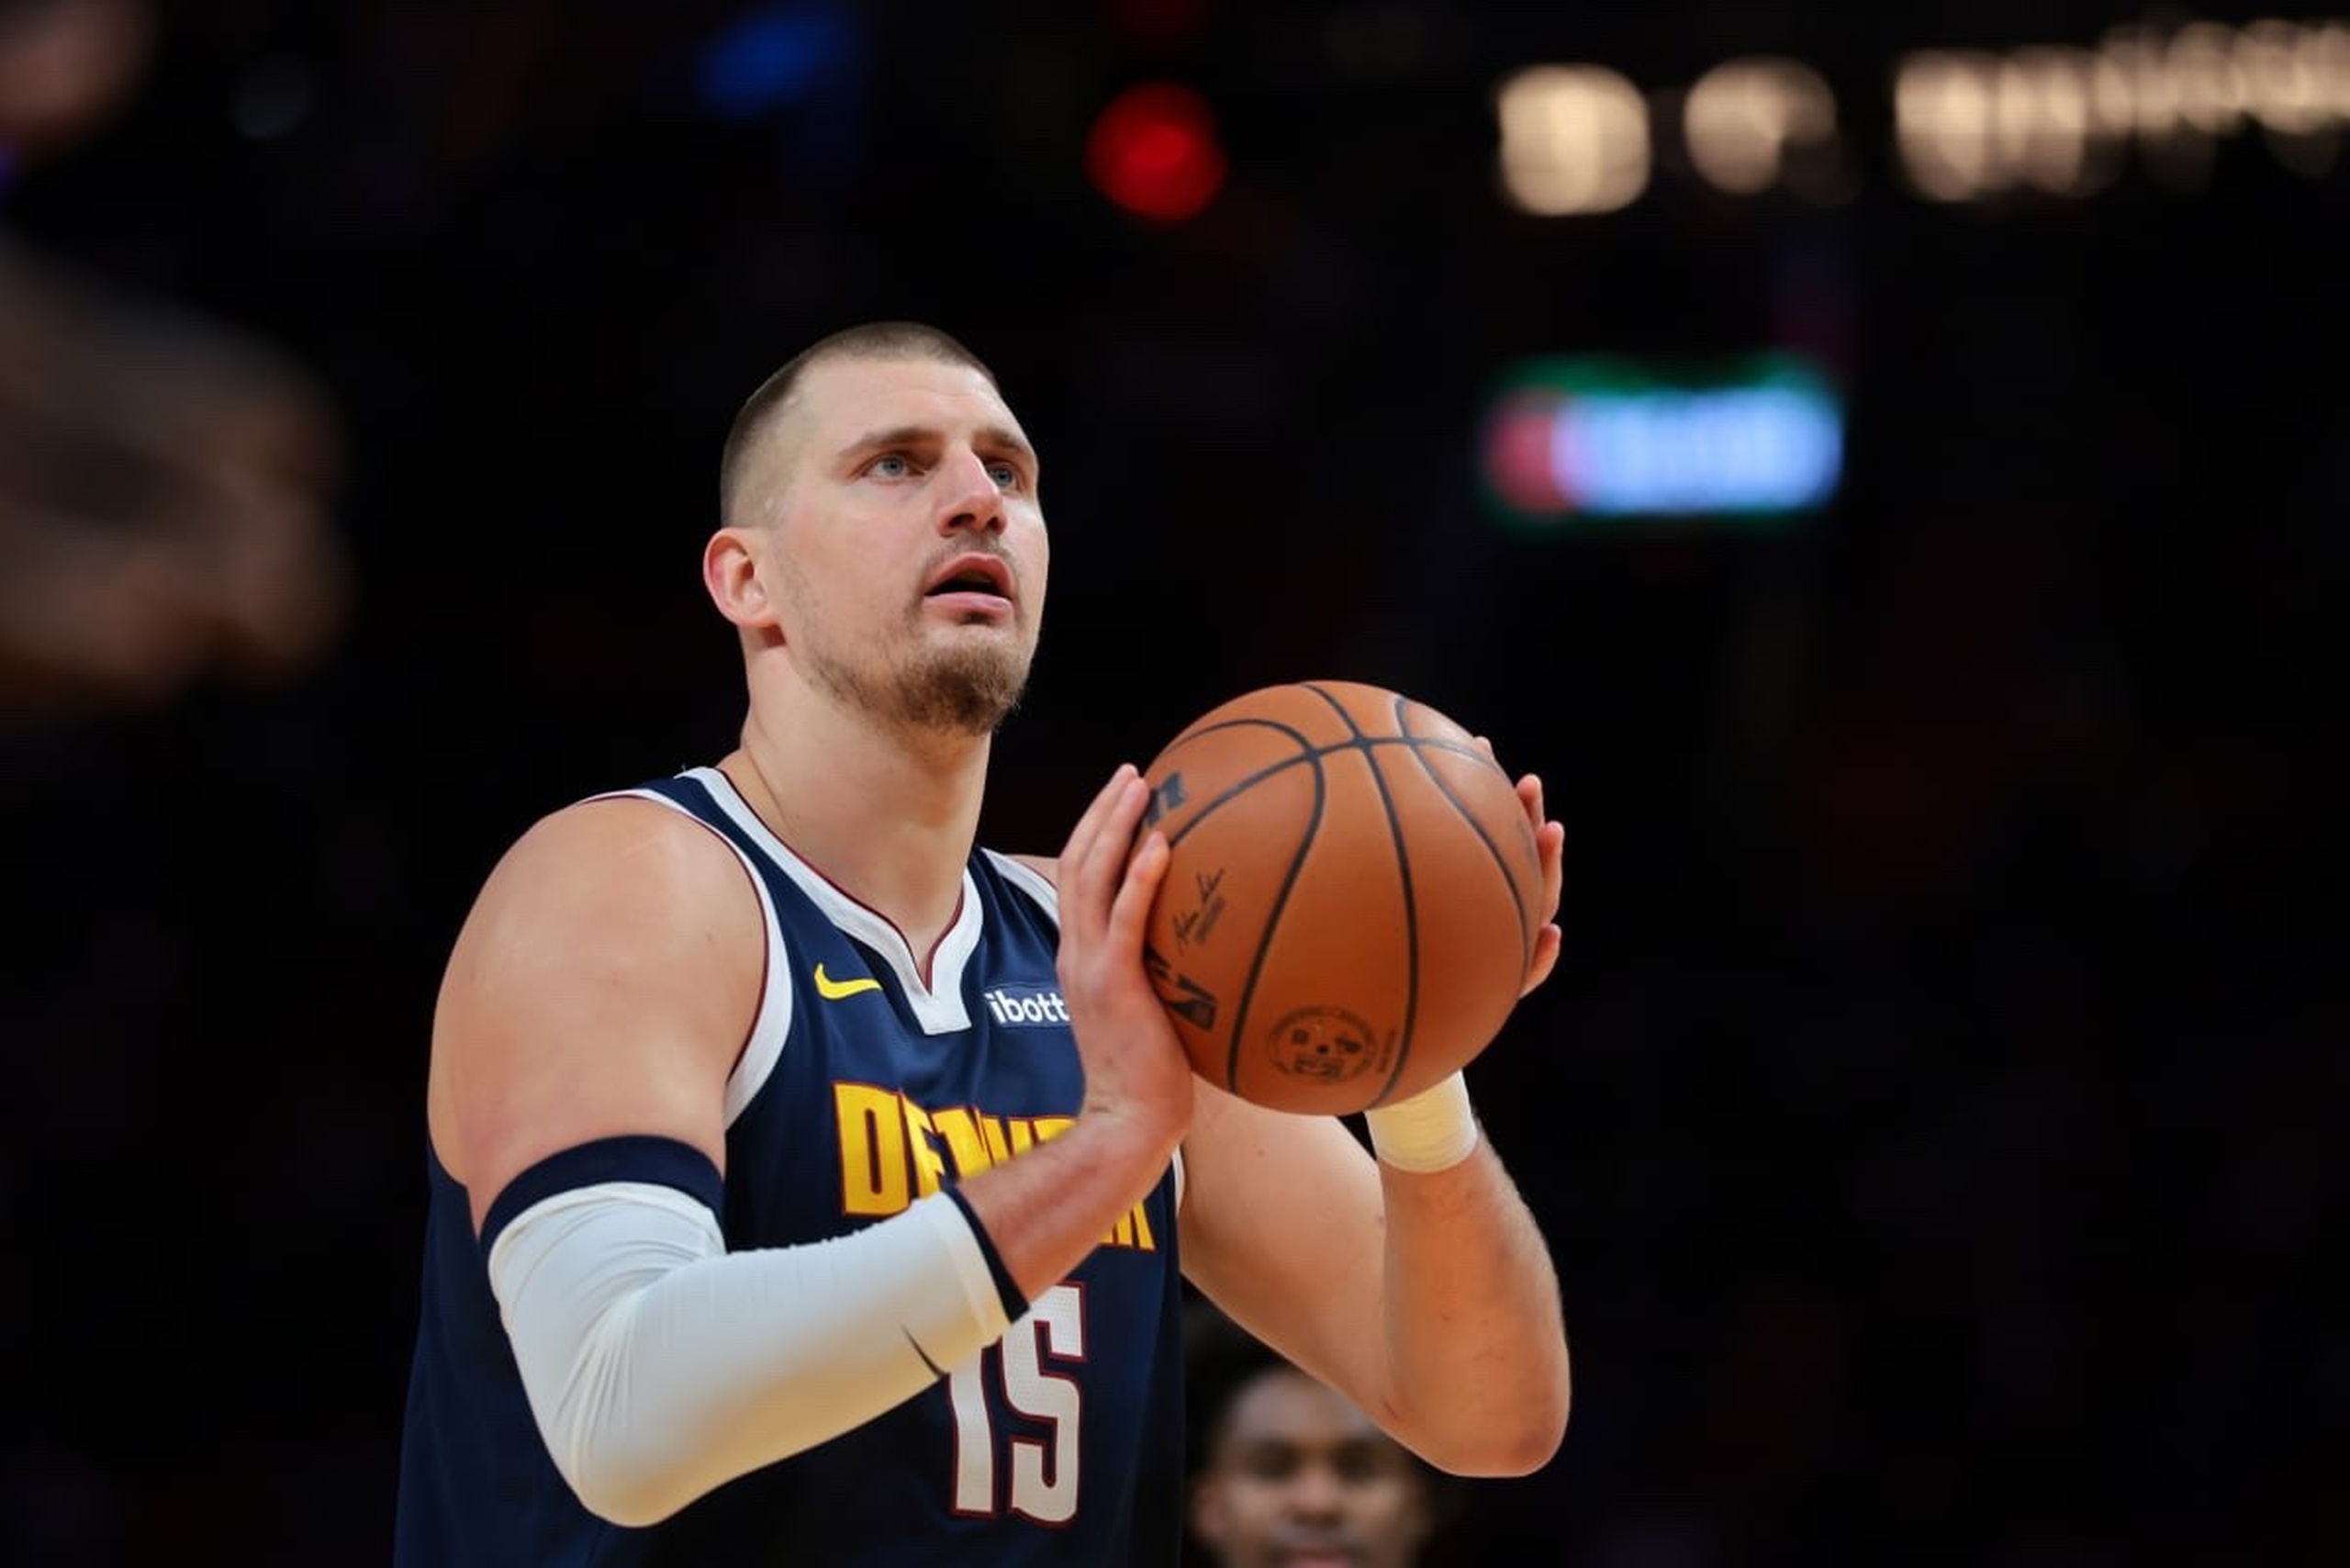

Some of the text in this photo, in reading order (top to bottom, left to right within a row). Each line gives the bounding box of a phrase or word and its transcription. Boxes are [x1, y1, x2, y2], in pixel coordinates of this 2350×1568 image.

[983, 990, 1070, 1024] ibott
[834, 1082, 1156, 1252] DEN
[946, 1281, 1087, 1529] 15
